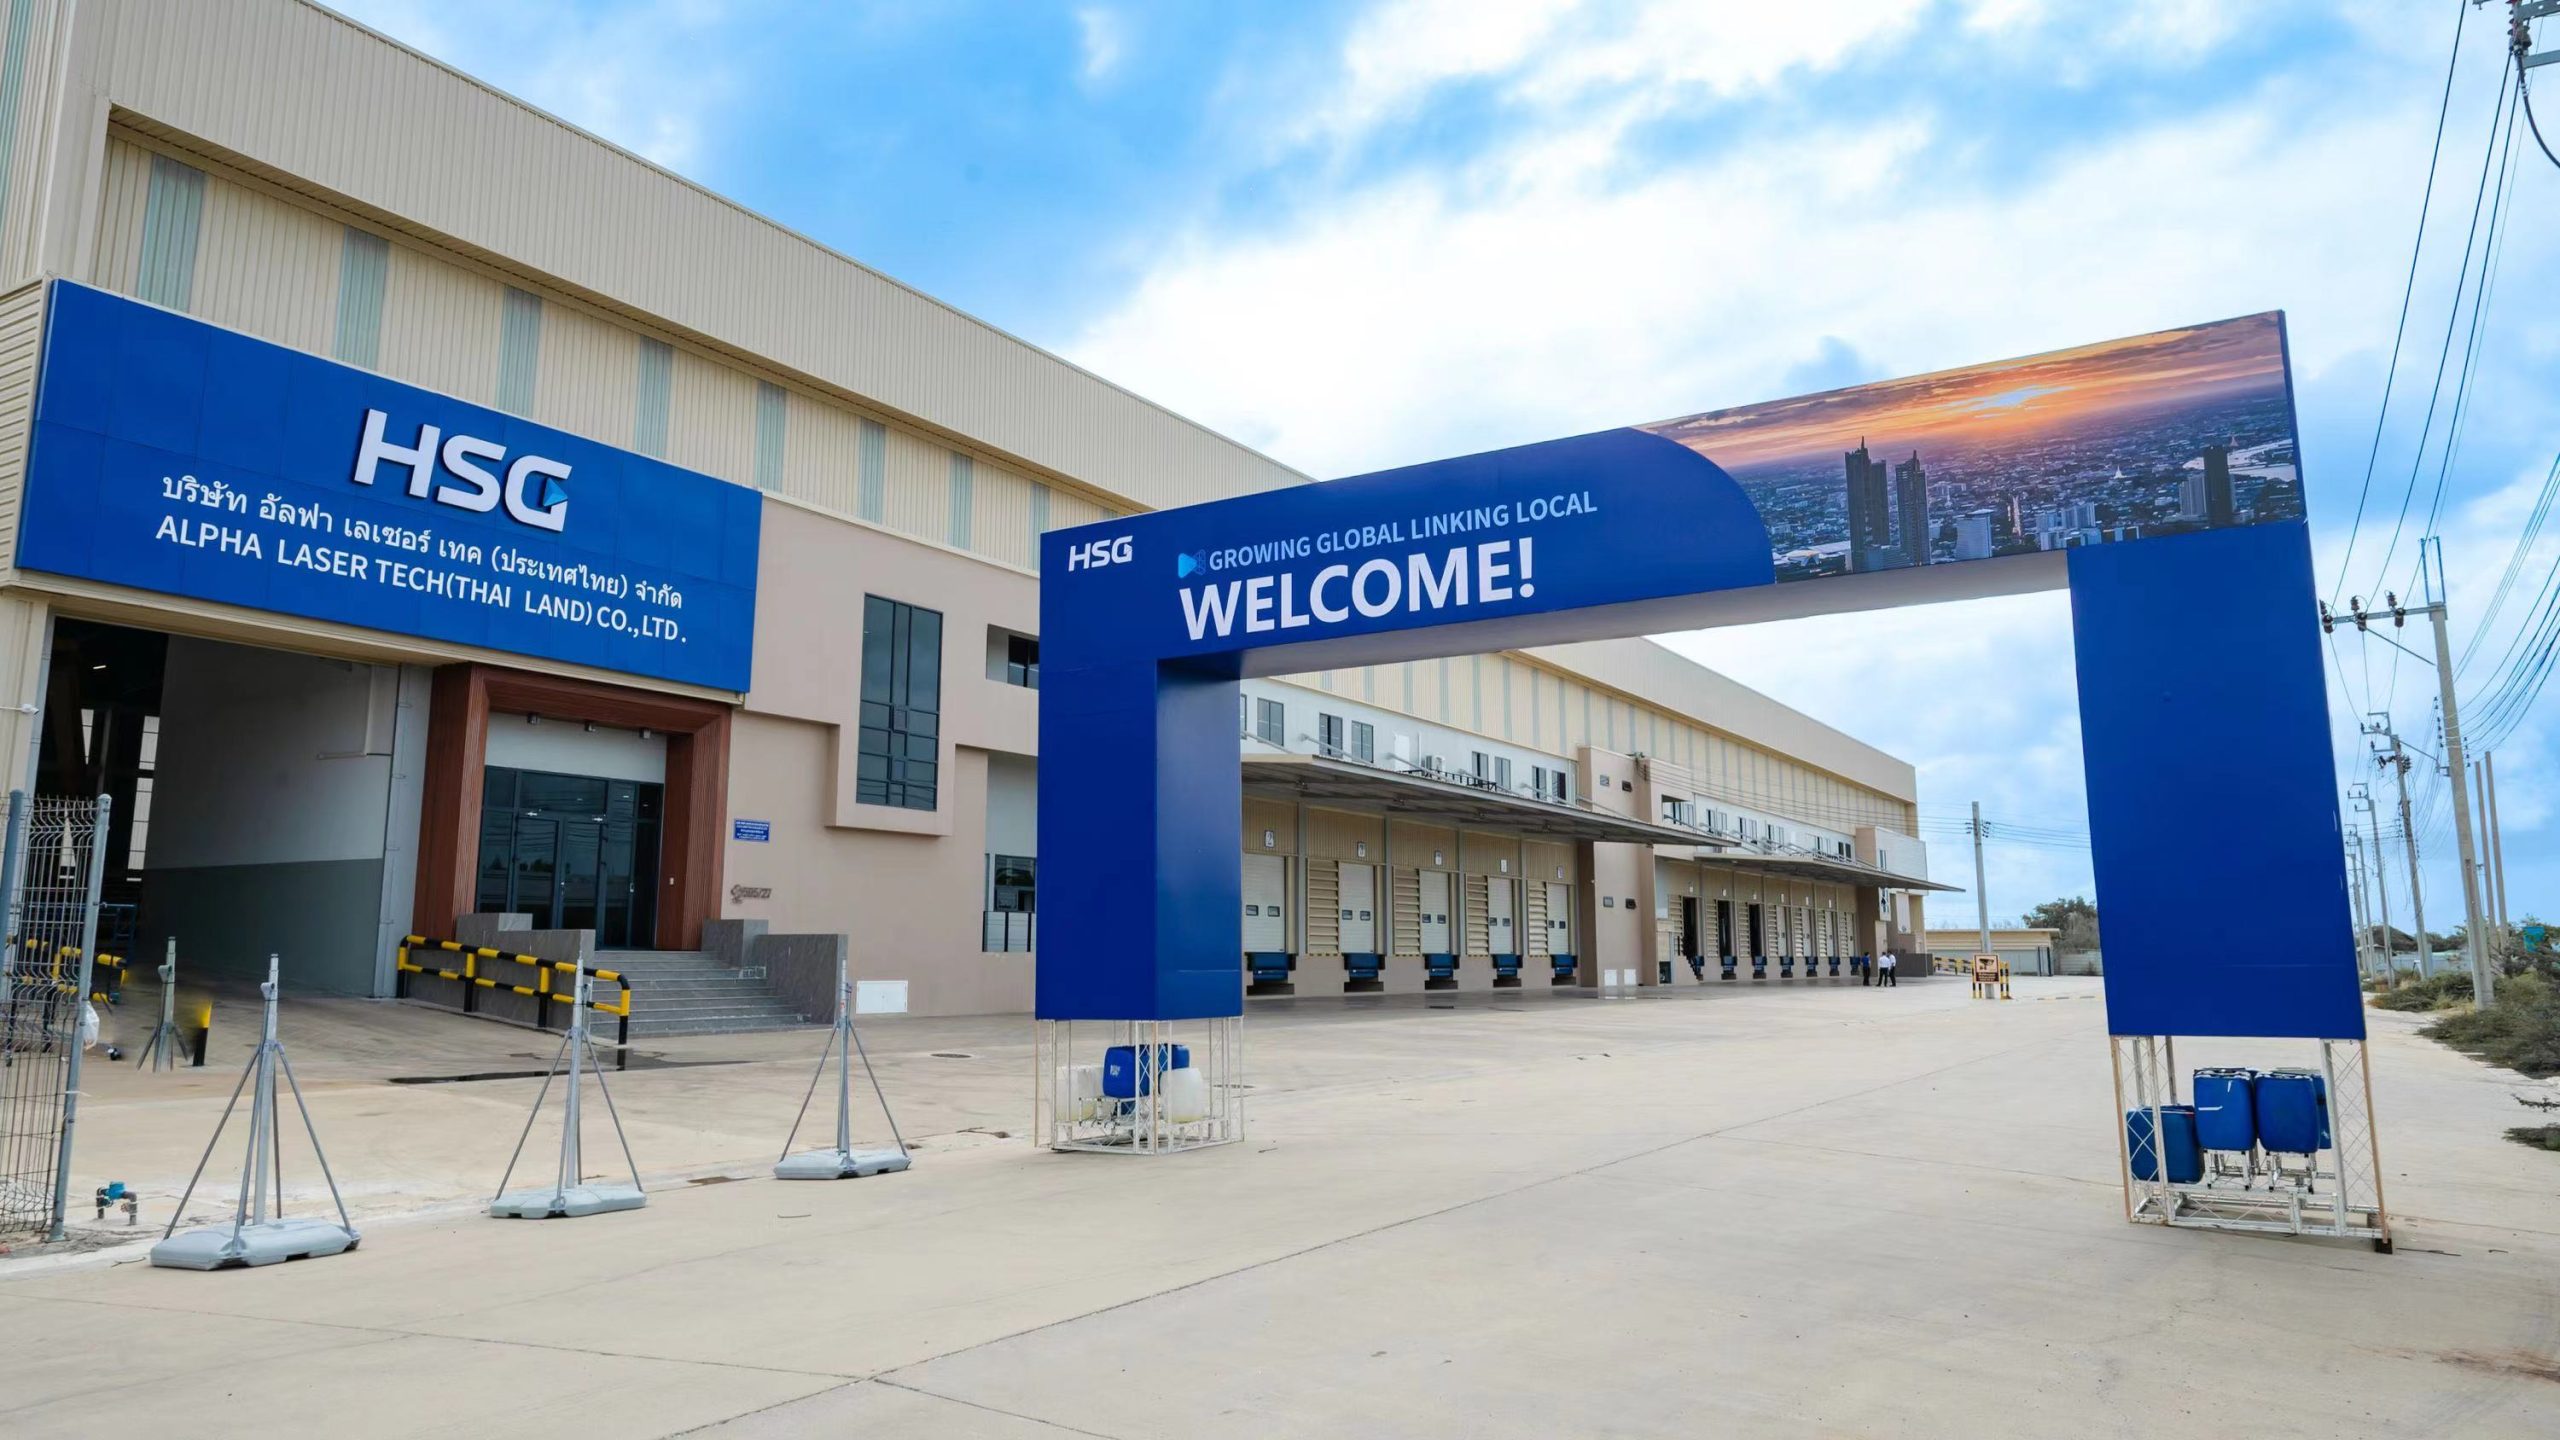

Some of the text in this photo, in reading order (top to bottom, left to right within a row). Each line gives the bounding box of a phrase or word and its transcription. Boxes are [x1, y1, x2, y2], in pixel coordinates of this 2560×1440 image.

[354, 408, 573, 532] HSG
[155, 515, 262, 560] ALPHA
[277, 538, 368, 580] LASER
[375, 558, 511, 608] TECH(THAI
[162, 475, 682, 609] บริษัท อัลฟา เลเซอร์ เทค (ประเทศไทย) จำกัด
[1068, 535, 1133, 572] HSG
[1209, 491, 1598, 571] GROWING GLOBAL LINKING LOCAL
[1179, 536, 1535, 641] WELCOME!
